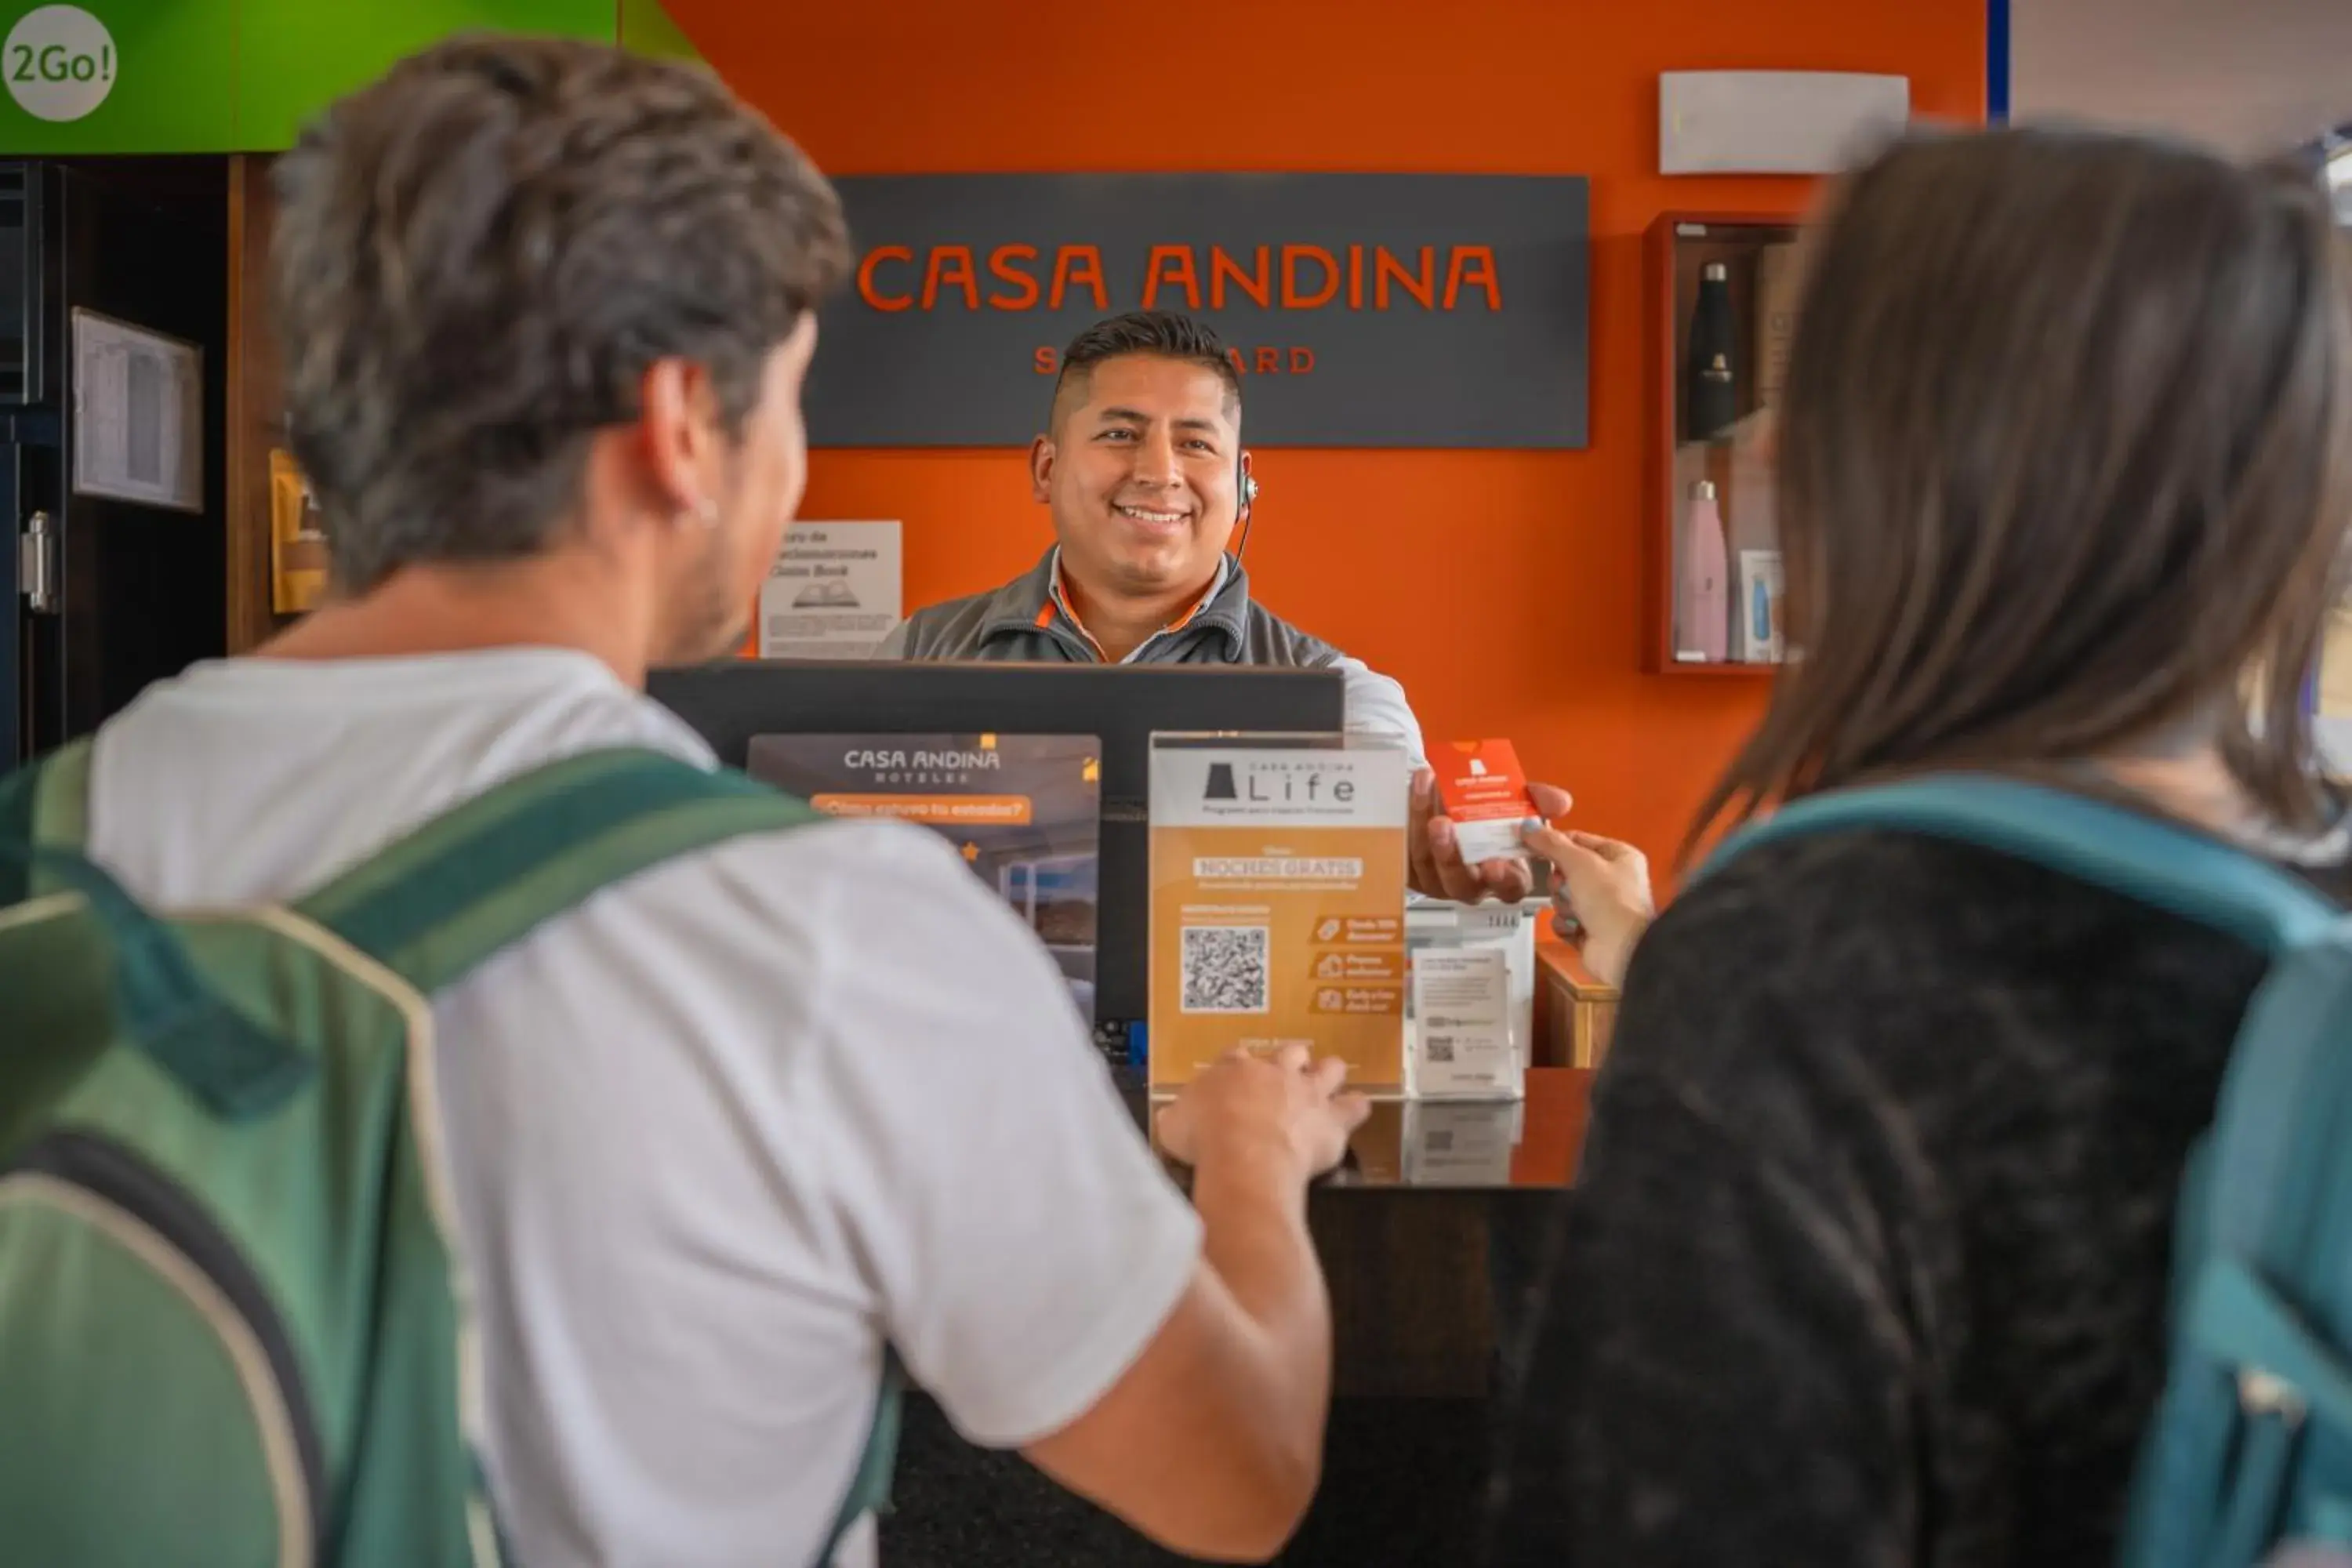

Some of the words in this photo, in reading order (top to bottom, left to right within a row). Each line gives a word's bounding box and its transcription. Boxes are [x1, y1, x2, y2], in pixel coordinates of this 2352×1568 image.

[13, 44, 110, 82] 2Go!
[857, 245, 1107, 312] CASA
[1142, 244, 1502, 310] ANDINA
[844, 750, 906, 769] CASA
[911, 750, 1000, 770] ANDINA
[875, 772, 968, 784] HOTELES
[1249, 772, 1355, 802] Life
[1200, 859, 1280, 876] NOCHES
[1284, 859, 1356, 876] GRATIS
